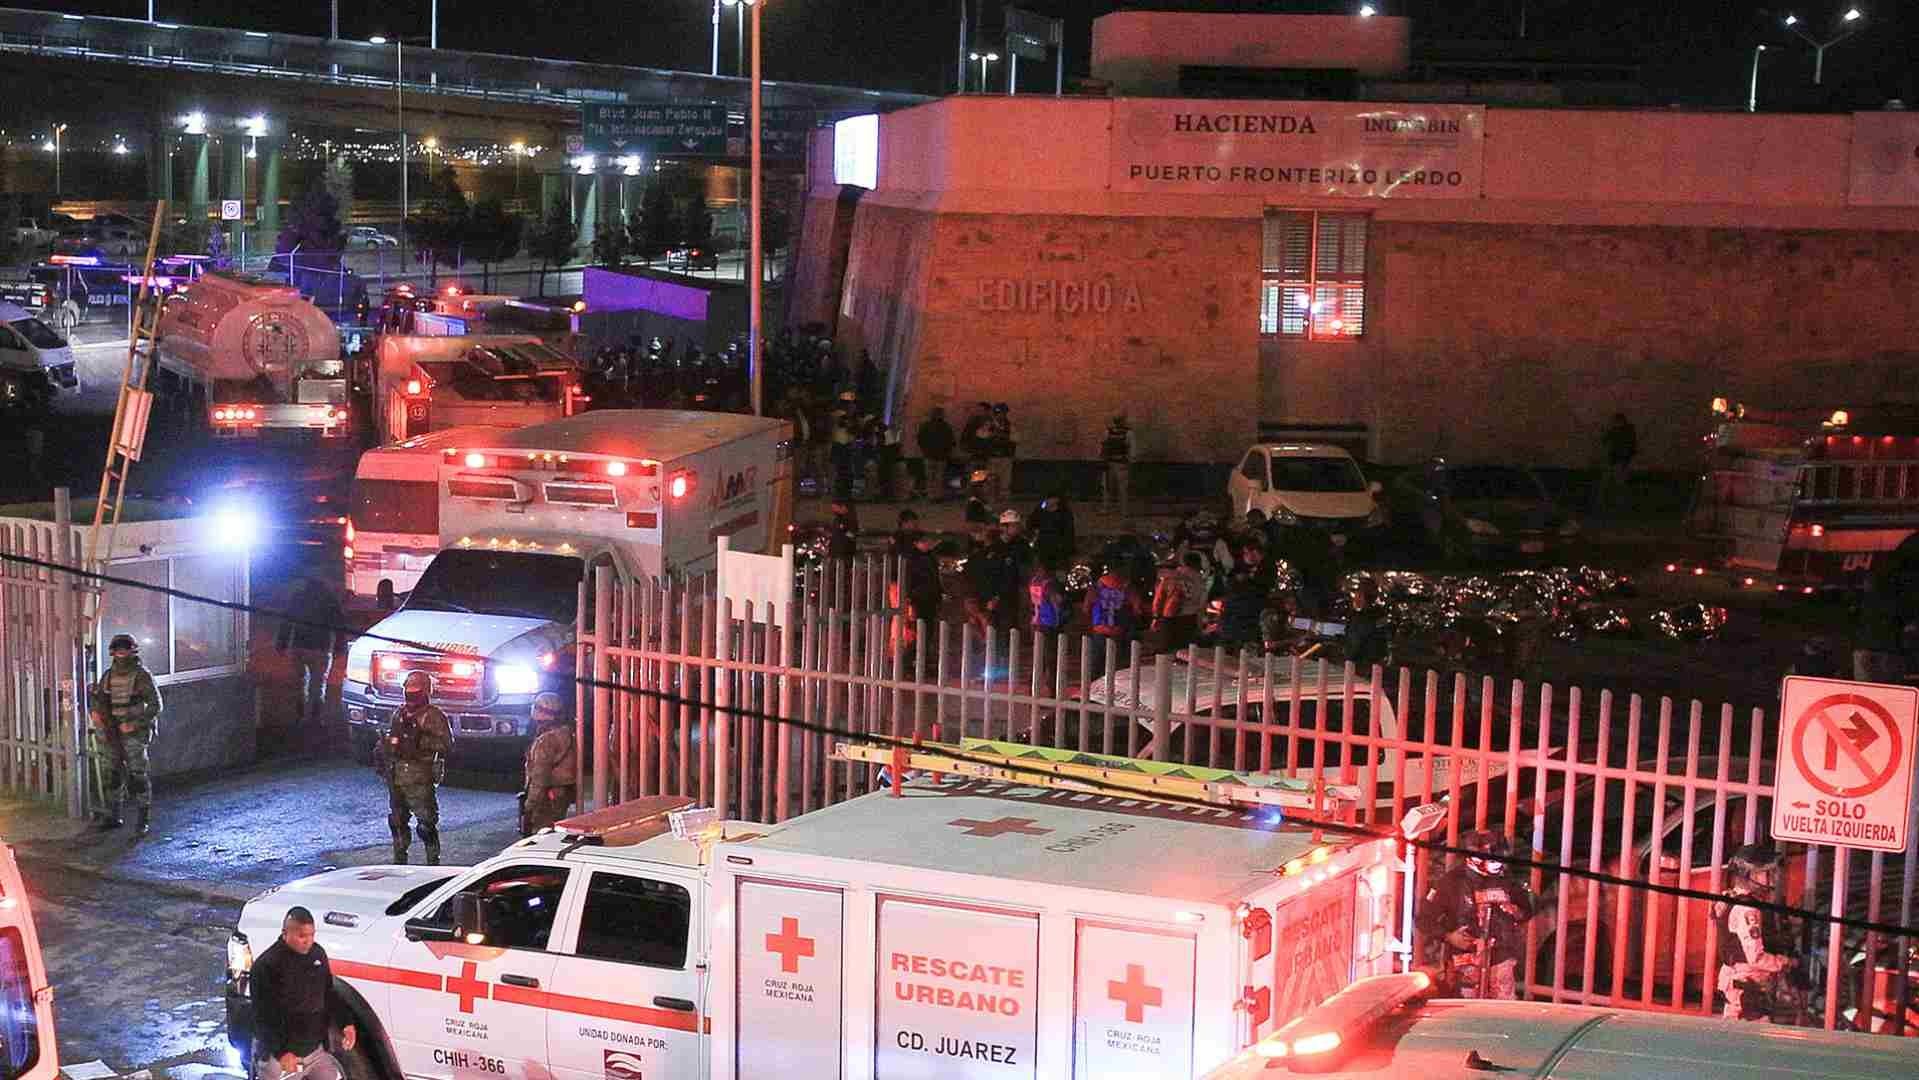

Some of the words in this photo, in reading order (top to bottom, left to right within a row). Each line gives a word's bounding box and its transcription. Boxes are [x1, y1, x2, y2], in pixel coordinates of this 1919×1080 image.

[631, 107, 661, 119] Juan
[664, 107, 699, 119] Pablo
[1173, 113, 1317, 135] HACIENDA
[1130, 163, 1222, 181] PUERTO
[1229, 165, 1378, 184] FRONTERIZO
[1385, 168, 1463, 187] LERDO
[977, 279, 1112, 313] EDIFICIO
[1123, 280, 1145, 313] A
[1815, 799, 1867, 820] SOLO
[1783, 814, 1829, 835] VUELTA
[1831, 819, 1897, 842] IZQUIERDA
[891, 952, 1025, 988] RESCATE
[764, 979, 788, 989] CRUZ
[791, 982, 815, 993] ROJA
[765, 989, 814, 1002] MEXICANA
[894, 981, 1020, 1017] URBANO
[444, 1017, 465, 1028] CRUZ
[468, 1021, 489, 1031] ROJA
[445, 1026, 489, 1040] MEXICANA
[578, 1026, 609, 1041] UNIDAD
[609, 1031, 646, 1048] DONADA
[896, 1030, 929, 1052] CD.
[935, 1036, 1017, 1065] JUAREZ
[433, 1048, 469, 1068] CHIH
